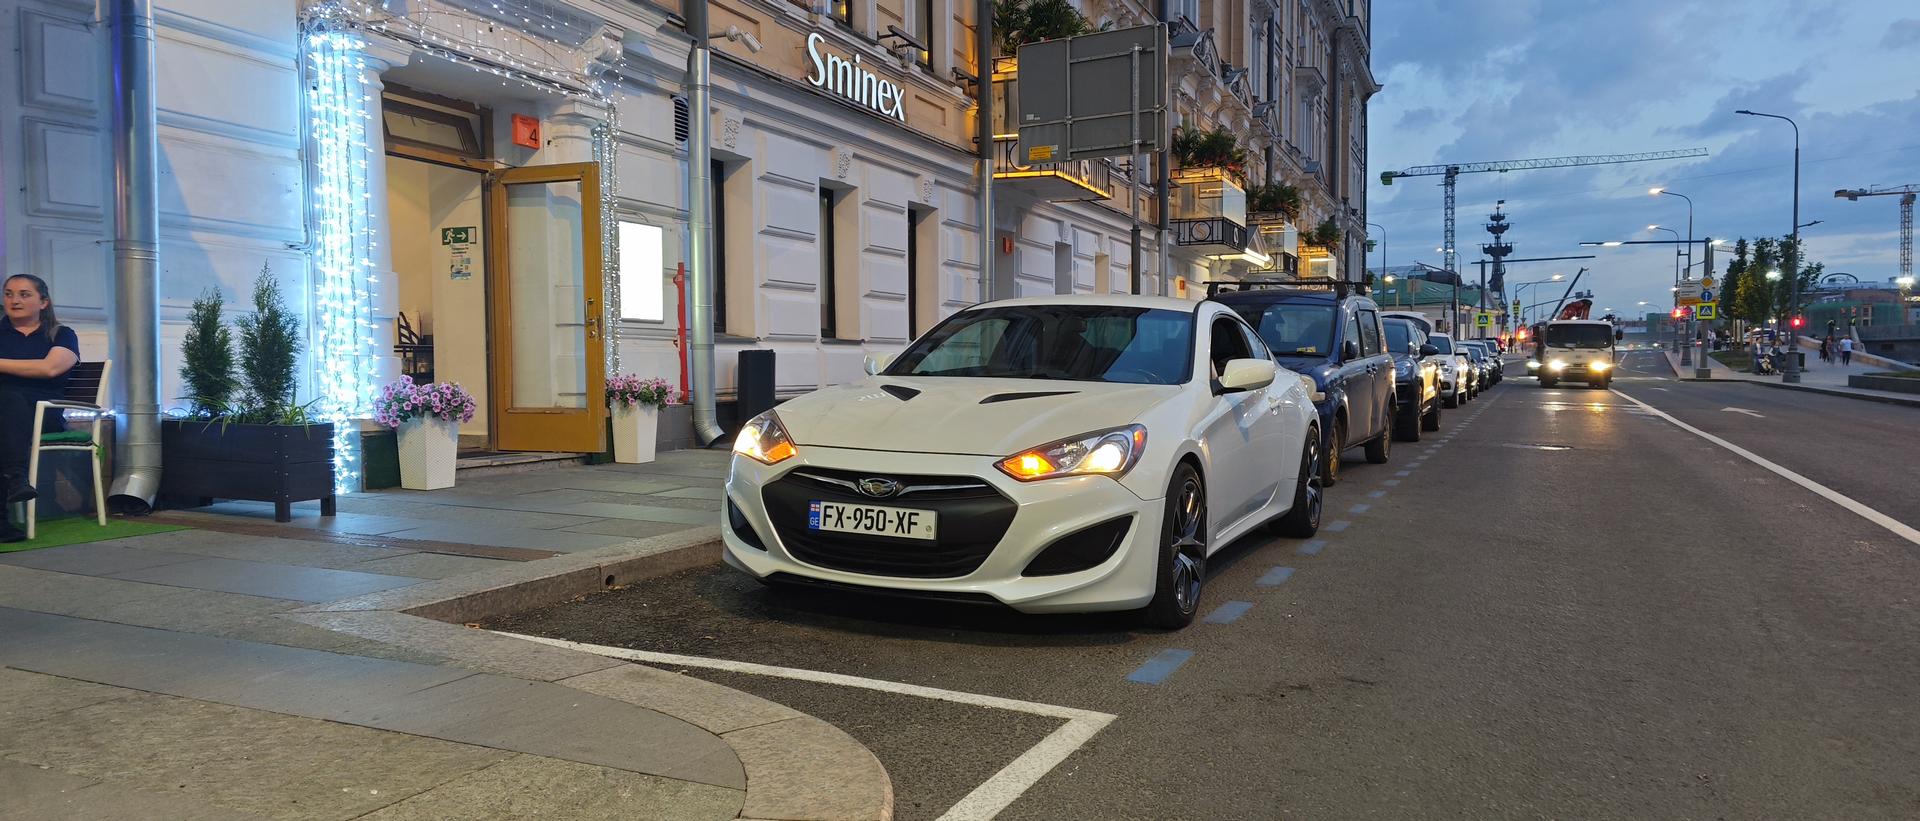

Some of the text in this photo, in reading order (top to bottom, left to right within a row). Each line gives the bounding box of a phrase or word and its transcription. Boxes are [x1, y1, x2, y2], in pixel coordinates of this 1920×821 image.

[807, 32, 905, 122] Sminex
[529, 128, 538, 144] 4
[809, 516, 820, 527] GE
[823, 505, 920, 534] FX-950-XF
